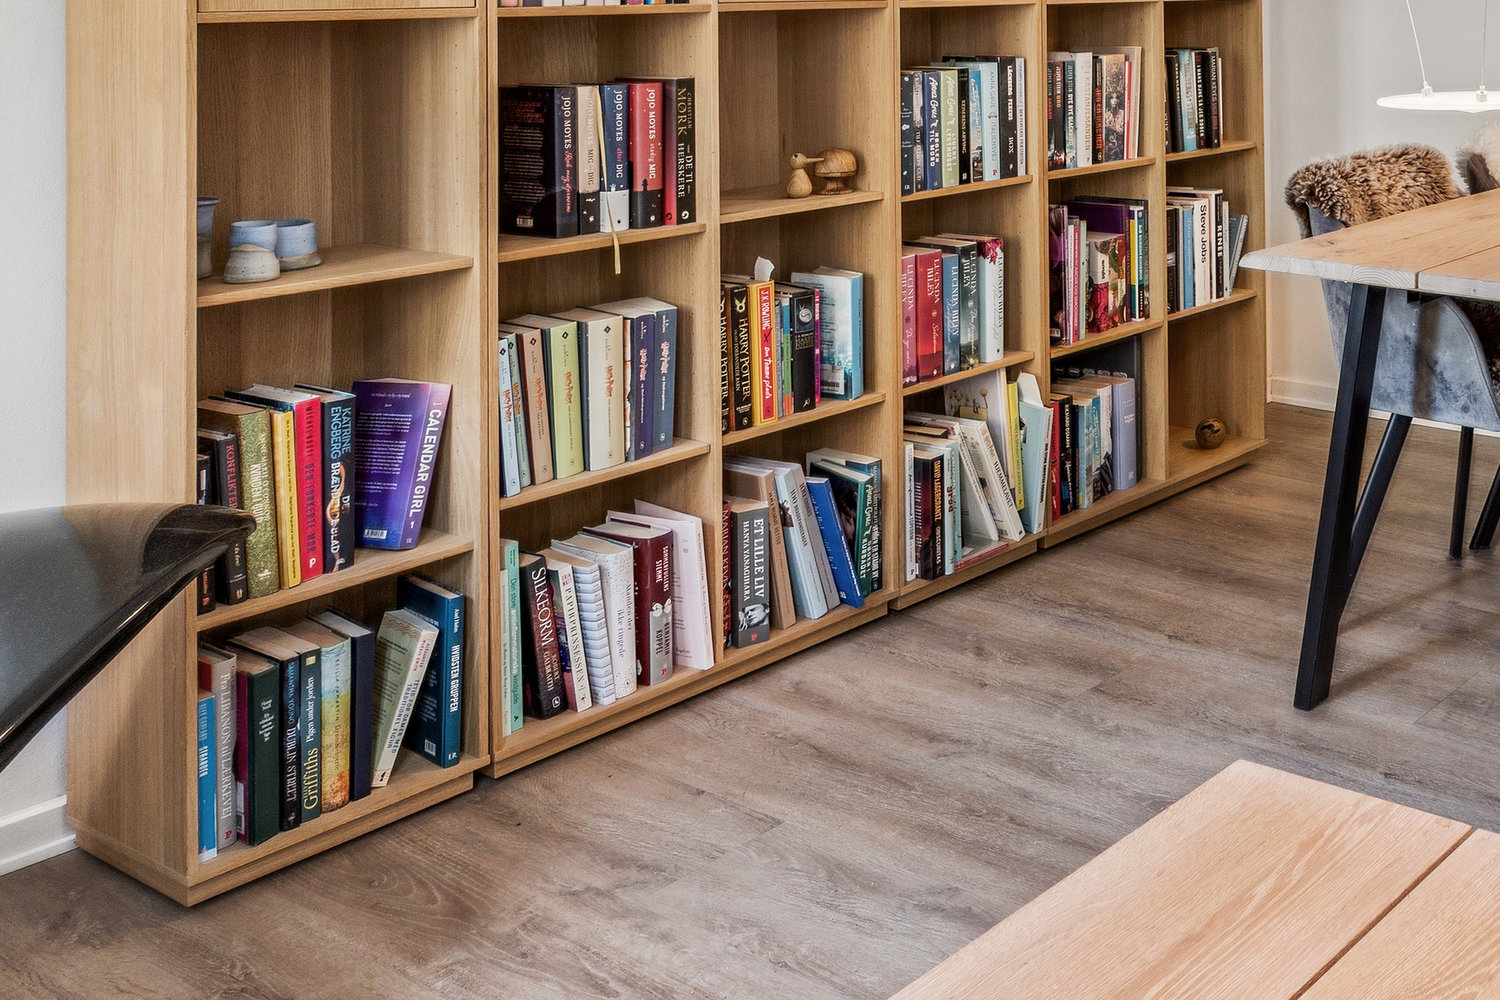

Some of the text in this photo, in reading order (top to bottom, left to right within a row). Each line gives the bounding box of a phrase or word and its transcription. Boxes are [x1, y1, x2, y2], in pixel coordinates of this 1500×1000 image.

[614, 90, 623, 111] JOJO
[647, 88, 656, 109] JOJO
[930, 77, 938, 118] Anna Grue
[678, 143, 686, 198] HERSKERE
[686, 155, 693, 182] DE TI
[738, 318, 751, 401] HARRY POTTER
[330, 406, 342, 460] ENGBERG
[342, 408, 352, 455] KATRINE
[416, 408, 442, 482] CALENDAR
[226, 444, 238, 509] KONFLIKTER
[409, 485, 426, 518] GIRL
[864, 484, 874, 526] Anna Grue
[754, 519, 764, 598] ET LILLE LIV
[532, 566, 554, 646] SILKEORM
[564, 587, 585, 684] PAPIRPRINSESSEN
[616, 609, 626, 658] ikke ringede
[220, 674, 230, 690] Fra
[450, 644, 460, 712] HVIDSTEN GRUPPEN
[544, 652, 554, 692] GALBRAITH
[221, 692, 232, 744] LIBANON
[306, 701, 314, 720] under
[306, 722, 315, 742] Pigen
[386, 682, 412, 749] TRADITIONEL FIGUR
[286, 727, 296, 764] DUBLIN
[221, 759, 232, 819] LÆRKEVEJ
[286, 766, 296, 802] STREET
[304, 748, 318, 810] Griffiths
